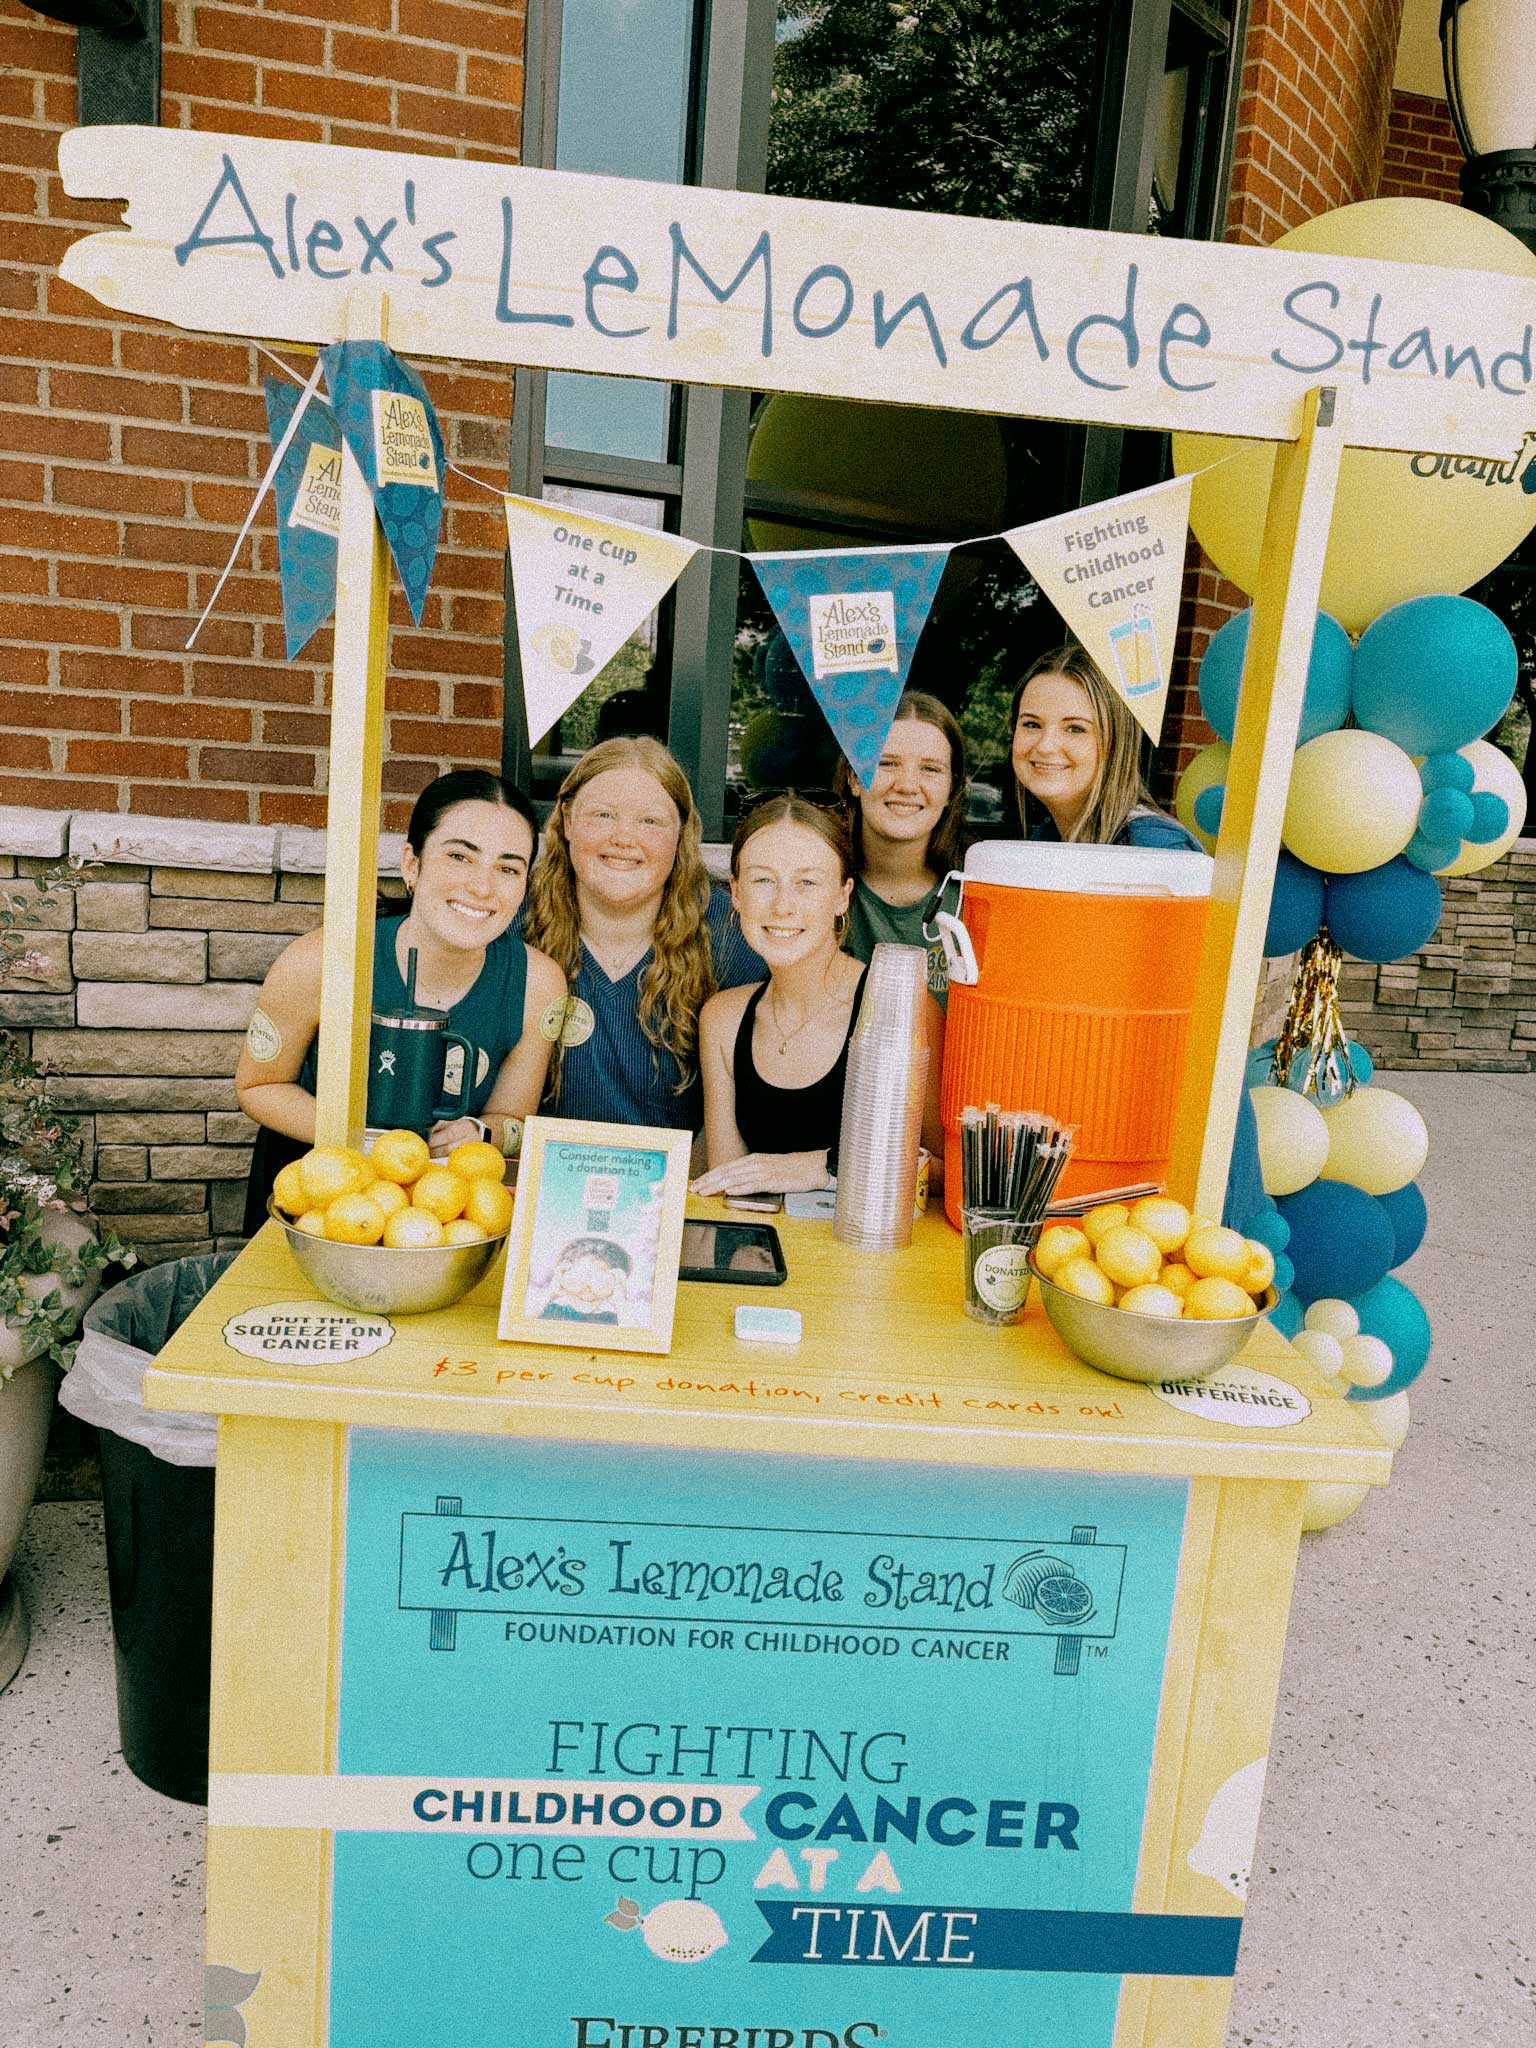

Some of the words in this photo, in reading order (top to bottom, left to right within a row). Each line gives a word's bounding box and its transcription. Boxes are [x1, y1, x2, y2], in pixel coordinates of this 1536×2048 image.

[174, 153, 457, 287] Alex's
[1271, 281, 1533, 396] Stand
[384, 399, 425, 432] Alex's
[386, 446, 418, 469] Stand
[553, 527, 594, 551] One
[599, 540, 637, 566] Cup
[1064, 515, 1149, 552] Fighting
[567, 565, 589, 581] at
[593, 572, 605, 585] a
[1063, 538, 1165, 584] Childhood
[554, 585, 604, 614] Time
[1088, 575, 1155, 609] Cancer
[822, 599, 881, 628] Alex's
[817, 623, 889, 643] Lemonade
[823, 639, 865, 660] Stand
[559, 1148, 609, 1162] Consider
[611, 1154, 652, 1170] making
[576, 1161, 625, 1176] donation
[628, 1168, 640, 1177] to
[234, 1325, 338, 1337] SQUEEZE
[351, 1325, 383, 1337] ON
[271, 1316, 316, 1324] PUT
[262, 1338, 360, 1350] CANCER
[432, 1357, 478, 1378] $3
[496, 1368, 553, 1384] per
[572, 1371, 636, 1391] cup
[838, 1390, 942, 1409] credit
[962, 1398, 1061, 1416] cards
[1160, 1383, 1300, 1410] DIFFERENCE
[437, 1530, 587, 1597] Alex's
[607, 1540, 845, 1604] Lemonade
[863, 1554, 996, 1613] Stand
[504, 1621, 677, 1648] FOUNDATION
[687, 1628, 735, 1650] FOR
[744, 1631, 901, 1657] CHILDHOOD
[911, 1638, 1011, 1662] CANCER
[546, 1720, 909, 1784] FIGHTING
[413, 1788, 722, 1829] CHILDHOOD
[765, 1791, 1080, 1851] CANCER
[466, 1841, 586, 1882] one
[607, 1844, 727, 1900] cup
[753, 1847, 839, 1893] AT
[854, 1850, 903, 1893] A
[791, 1907, 979, 1964] TIME
